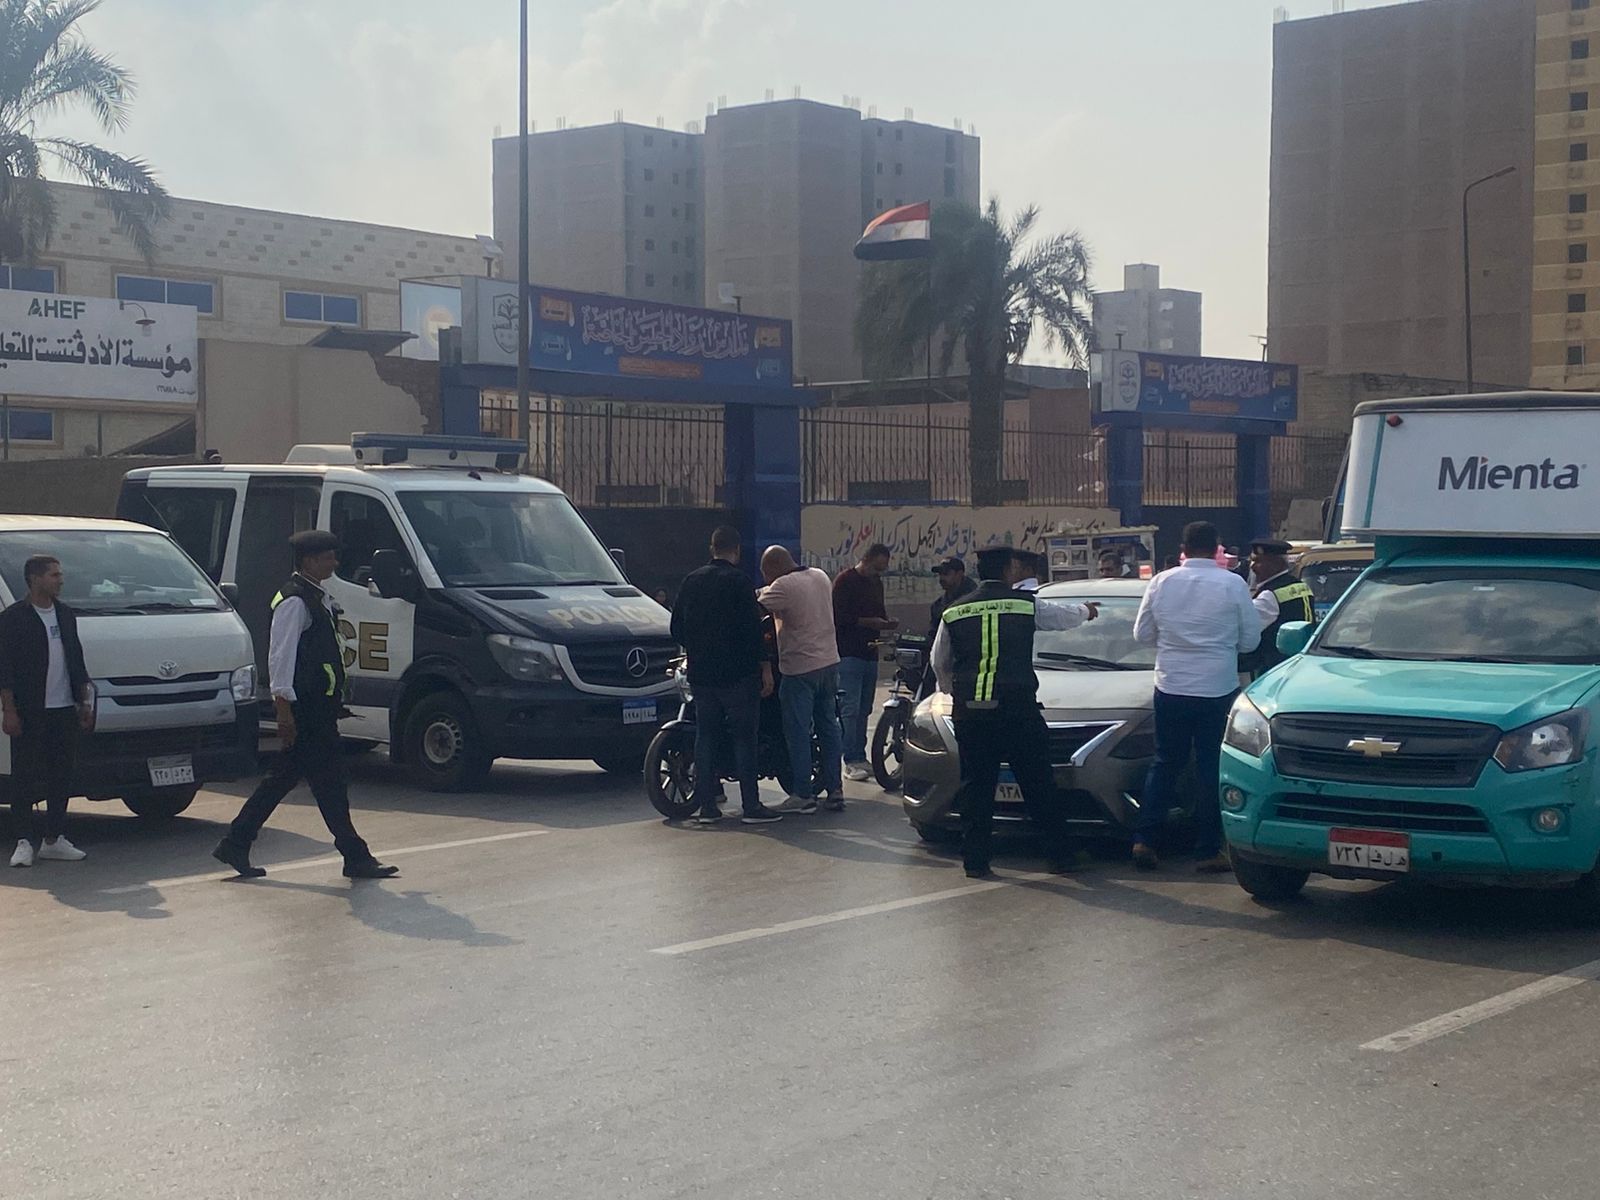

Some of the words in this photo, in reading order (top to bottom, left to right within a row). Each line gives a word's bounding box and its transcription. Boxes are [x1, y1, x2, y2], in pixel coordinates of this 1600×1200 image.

[28, 298, 86, 320] AHEF
[121, 338, 192, 378] مؤسسة
[1438, 456, 1580, 491] Mienta
[1335, 845, 1362, 864] ٧٣٢
